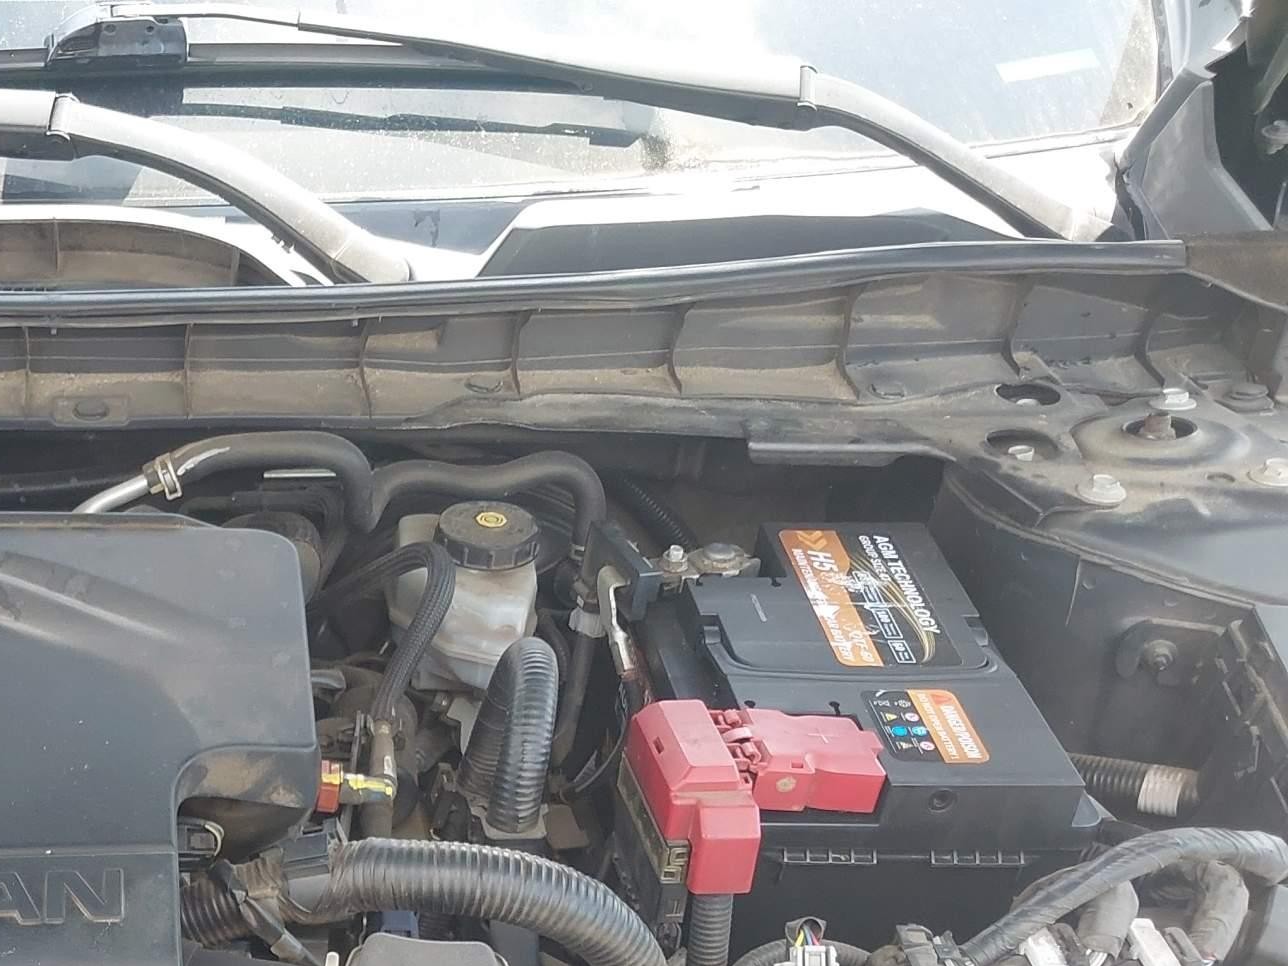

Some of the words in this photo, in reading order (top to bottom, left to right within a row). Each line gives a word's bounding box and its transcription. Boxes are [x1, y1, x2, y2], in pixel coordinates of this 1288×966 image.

[807, 550, 839, 572] H5
[859, 535, 879, 560] GROUP
[871, 559, 888, 575] SIZE
[873, 535, 899, 559] AGM
[888, 560, 941, 633] TECHNOLOGY
